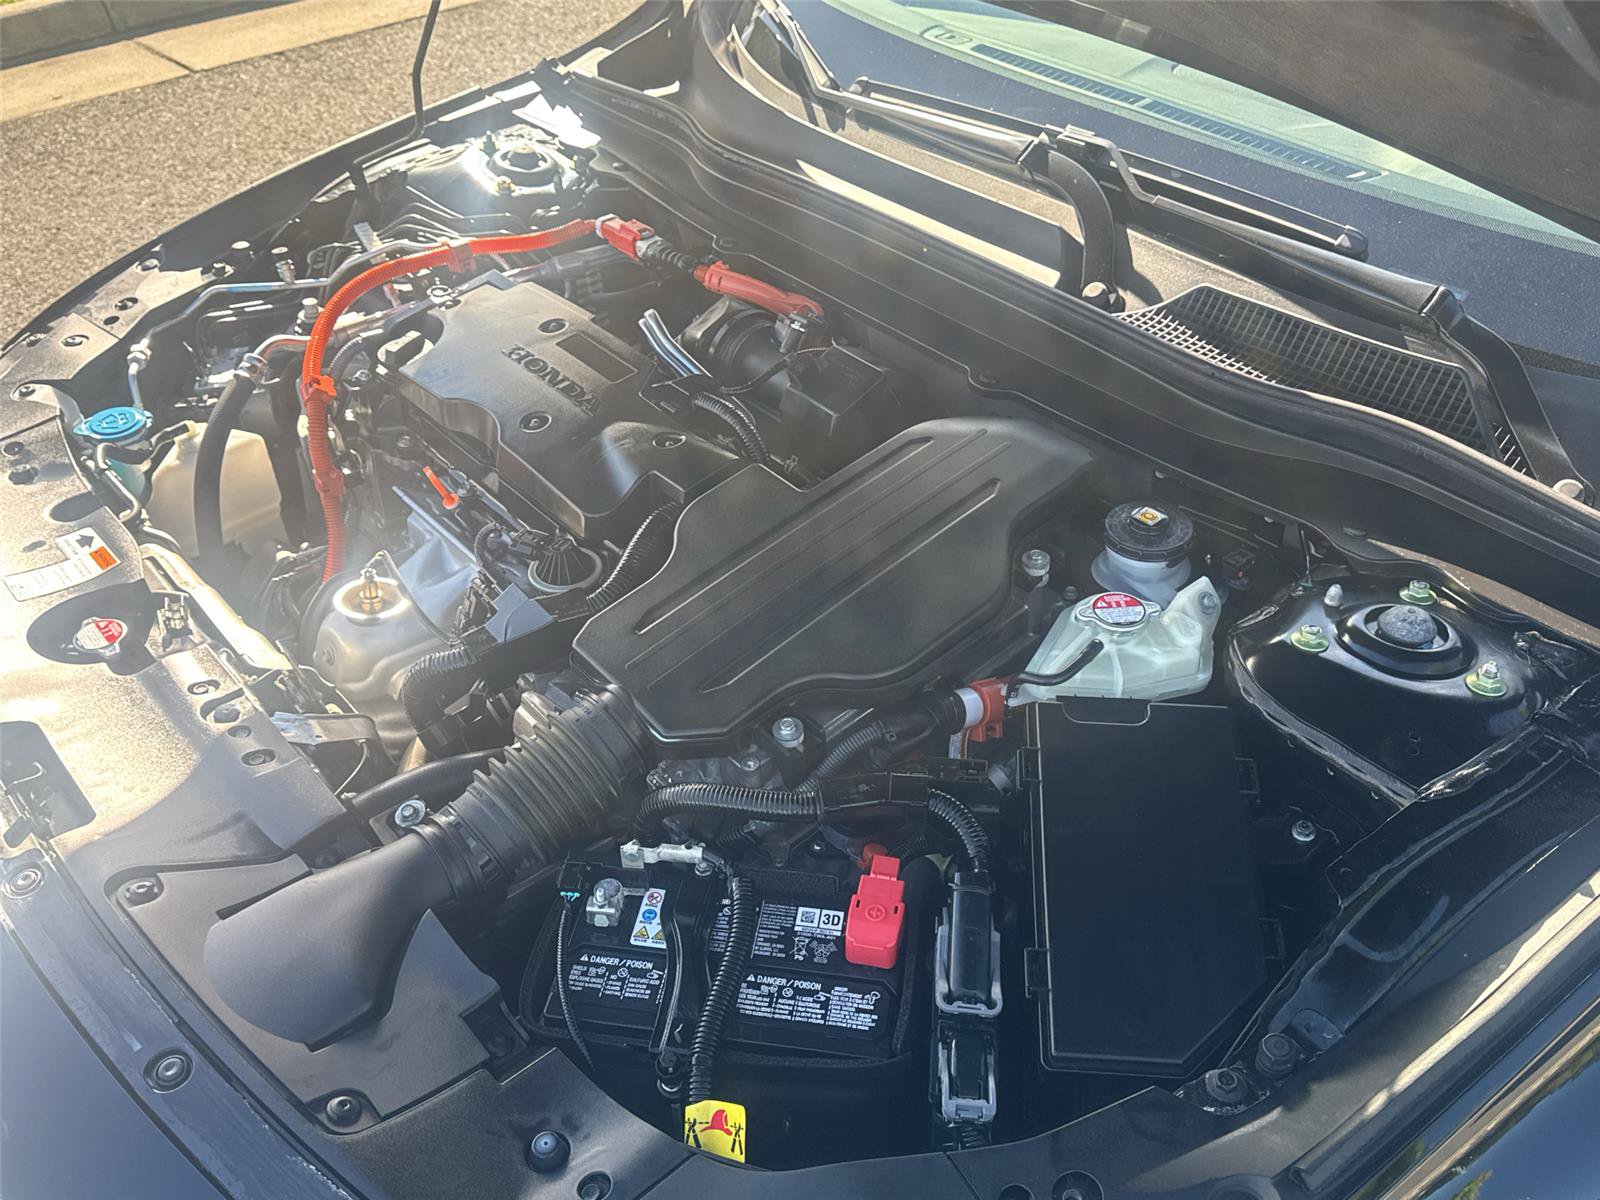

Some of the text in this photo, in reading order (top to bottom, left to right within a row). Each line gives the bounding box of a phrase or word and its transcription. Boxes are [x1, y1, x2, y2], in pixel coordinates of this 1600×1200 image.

[501, 343, 601, 417] HONDA
[822, 913, 841, 926] 3D
[590, 954, 620, 966] DANGER
[626, 960, 654, 970] POISON
[757, 974, 787, 987] DANGER
[793, 979, 822, 991] POISON
